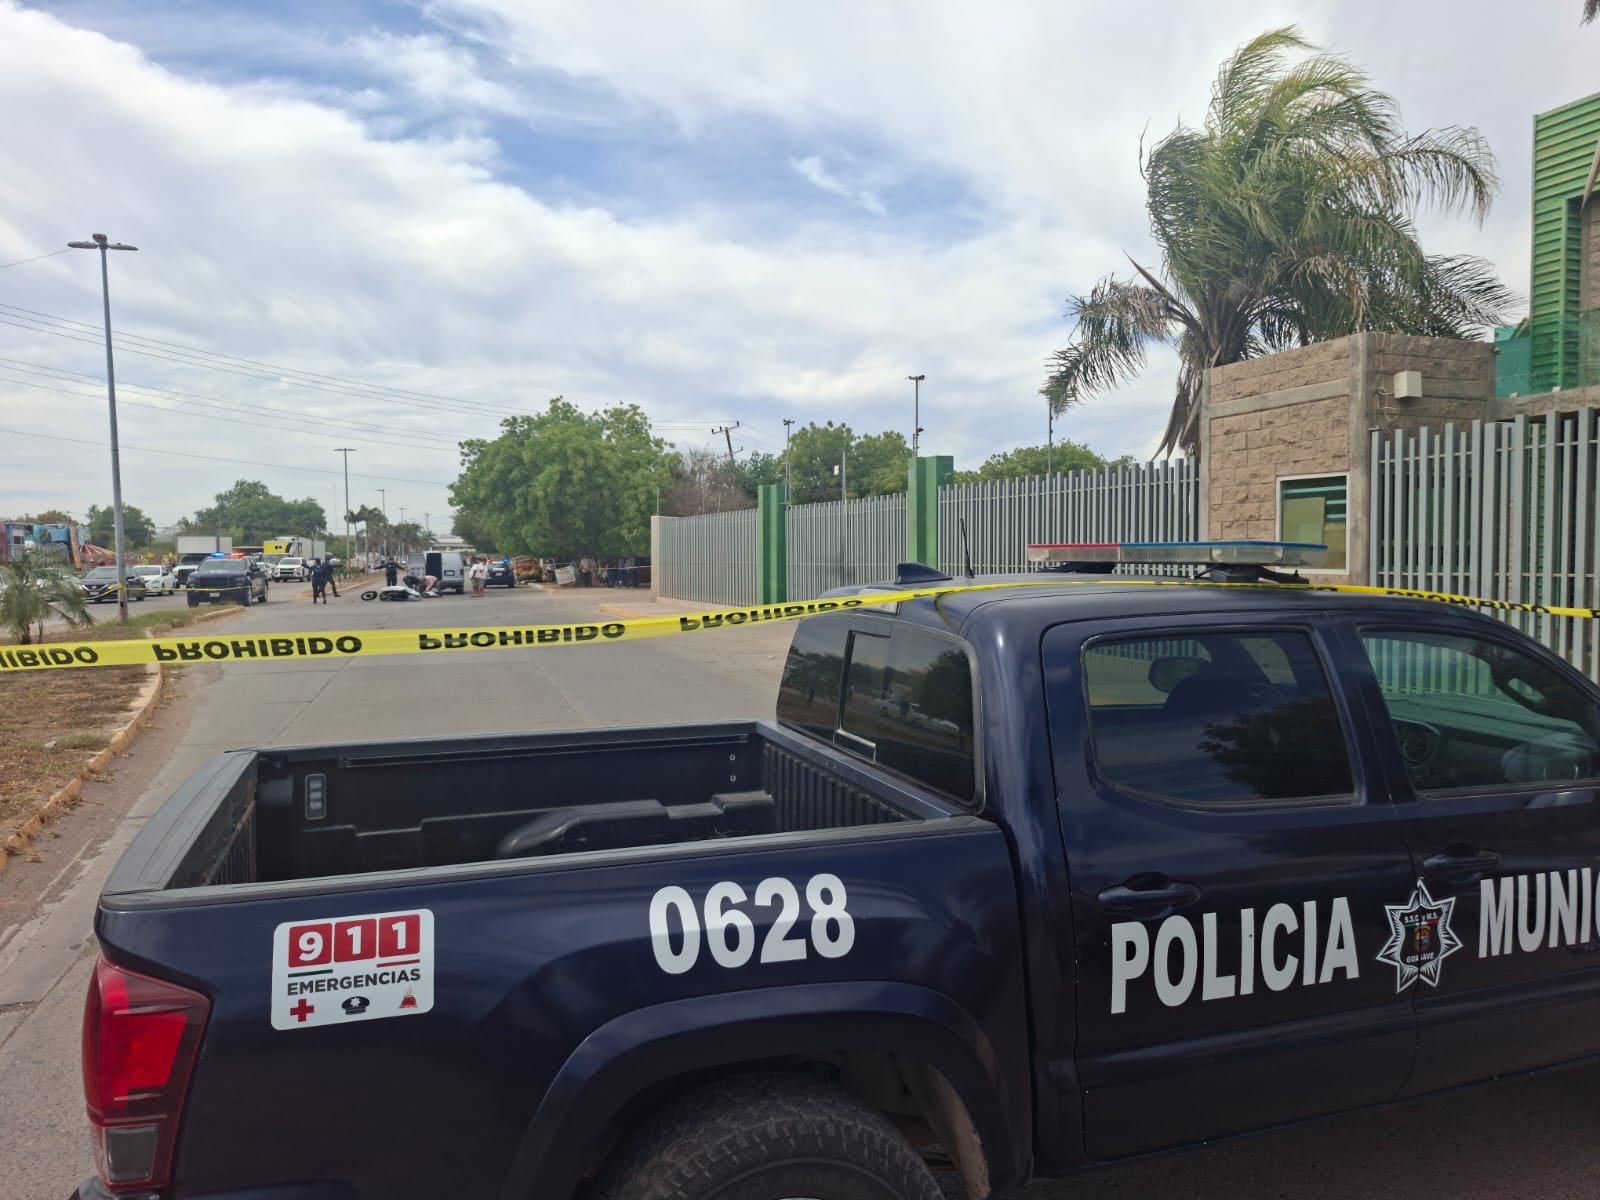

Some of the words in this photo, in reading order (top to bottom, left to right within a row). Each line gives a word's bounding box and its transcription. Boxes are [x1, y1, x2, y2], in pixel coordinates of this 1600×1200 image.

[299, 921, 407, 961] 911
[649, 873, 855, 974] 0628
[1111, 896, 1360, 1015] POLICIA
[1478, 867, 1600, 959] MUNI
[287, 968, 421, 996] EMERGENCIAS
